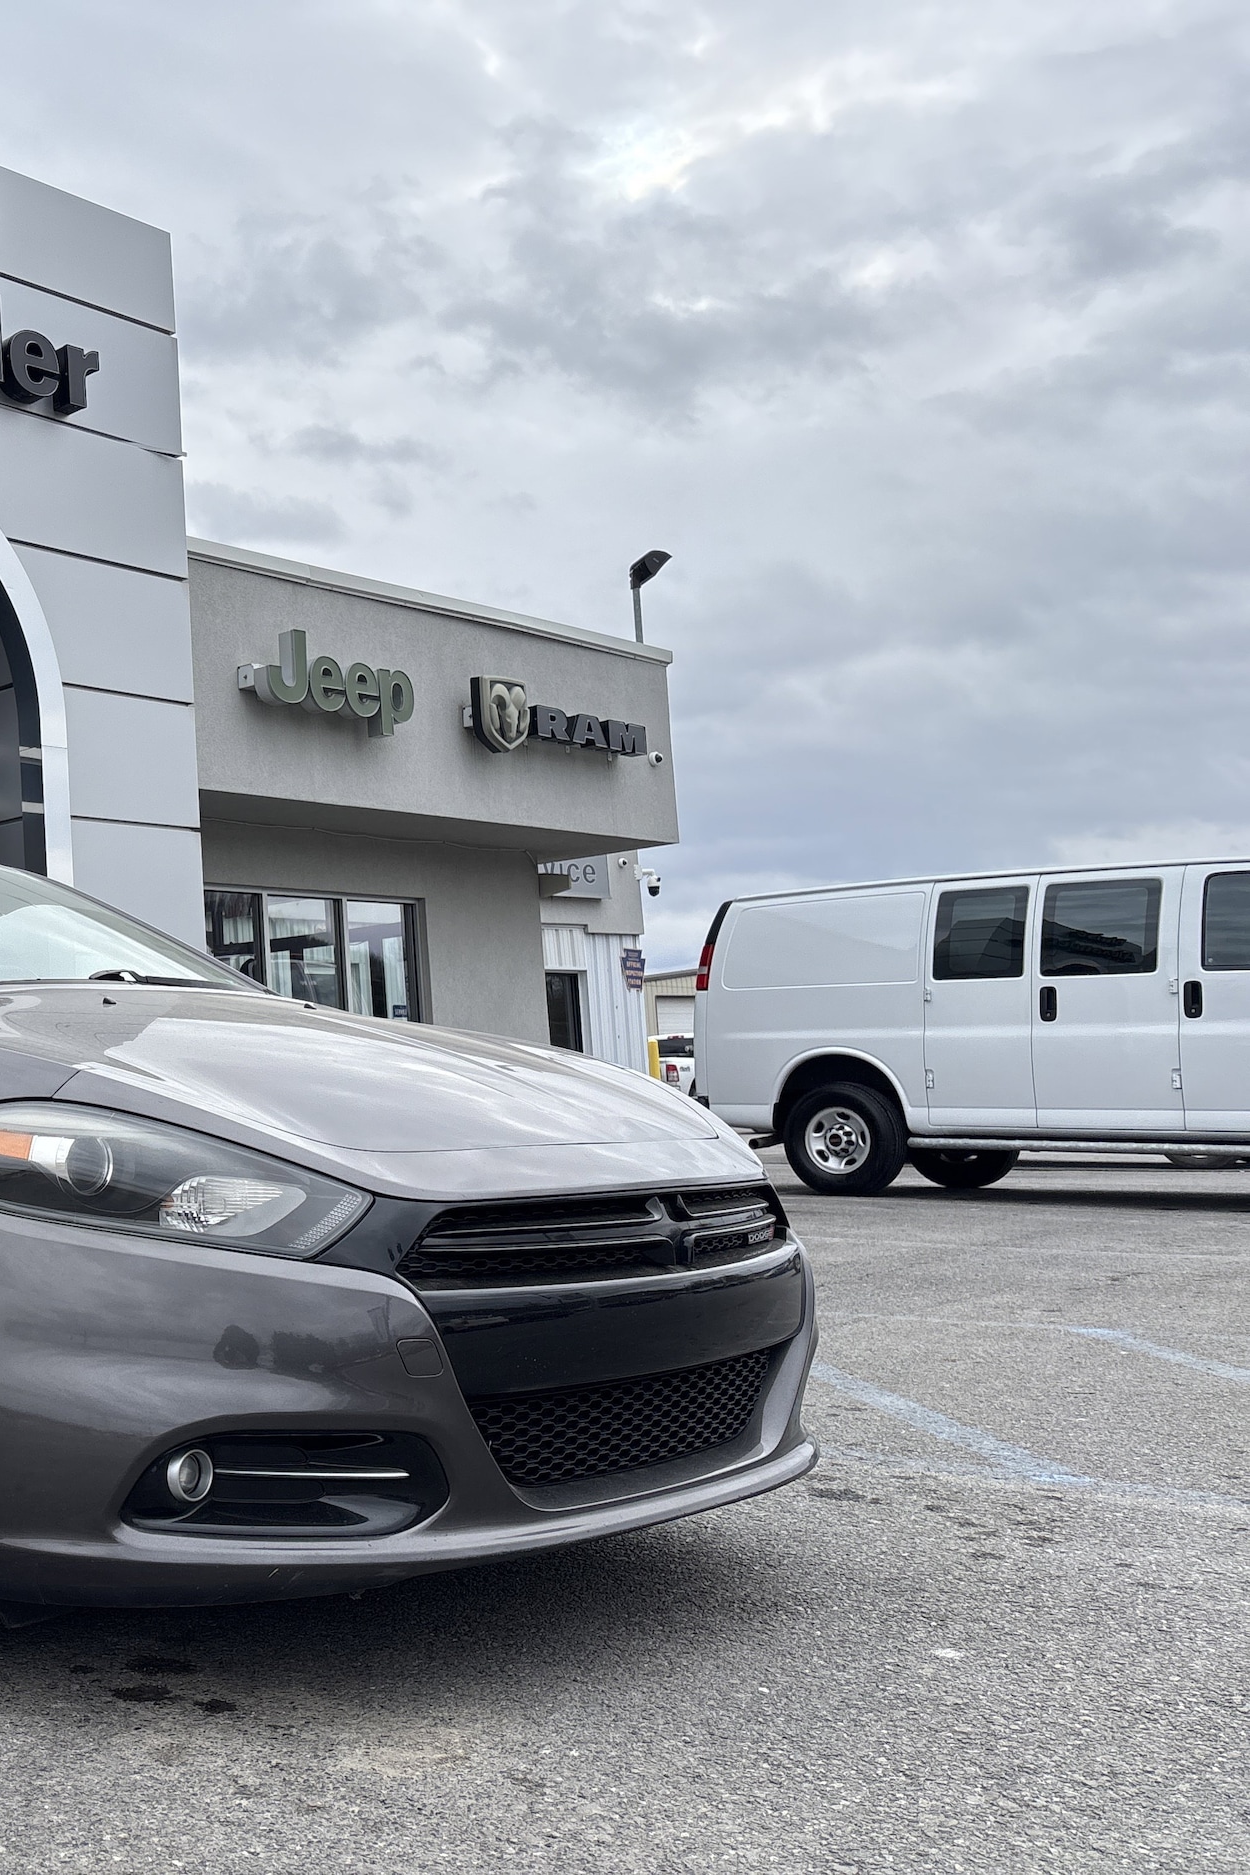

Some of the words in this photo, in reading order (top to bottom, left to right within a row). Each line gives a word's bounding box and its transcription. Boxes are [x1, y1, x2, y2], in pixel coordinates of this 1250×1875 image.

[254, 629, 414, 738] Jeep
[529, 704, 647, 757] RAM
[749, 1227, 775, 1243] DODGE
